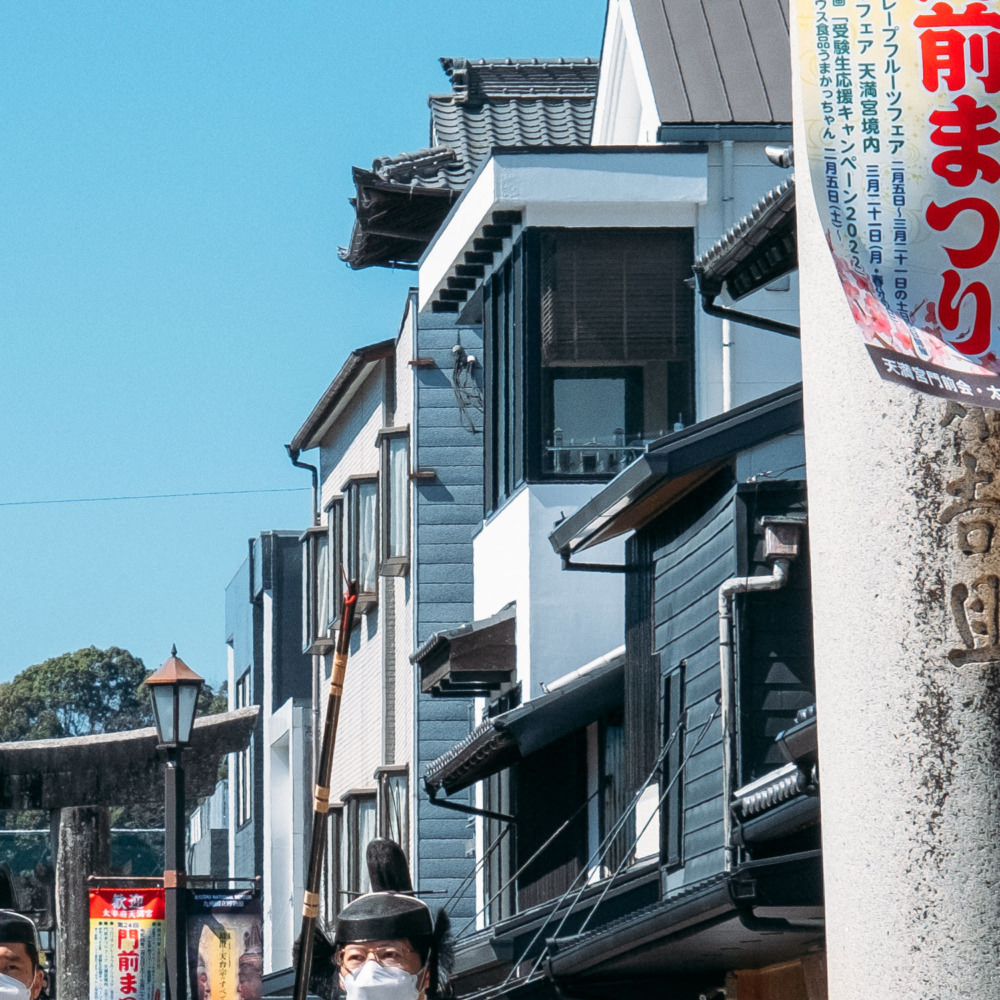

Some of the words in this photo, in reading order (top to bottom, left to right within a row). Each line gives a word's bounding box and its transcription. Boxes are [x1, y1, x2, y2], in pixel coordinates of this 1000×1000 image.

[858, 62, 880, 154] 天満宮境内
[913, 0, 1000, 355] 前まつり
